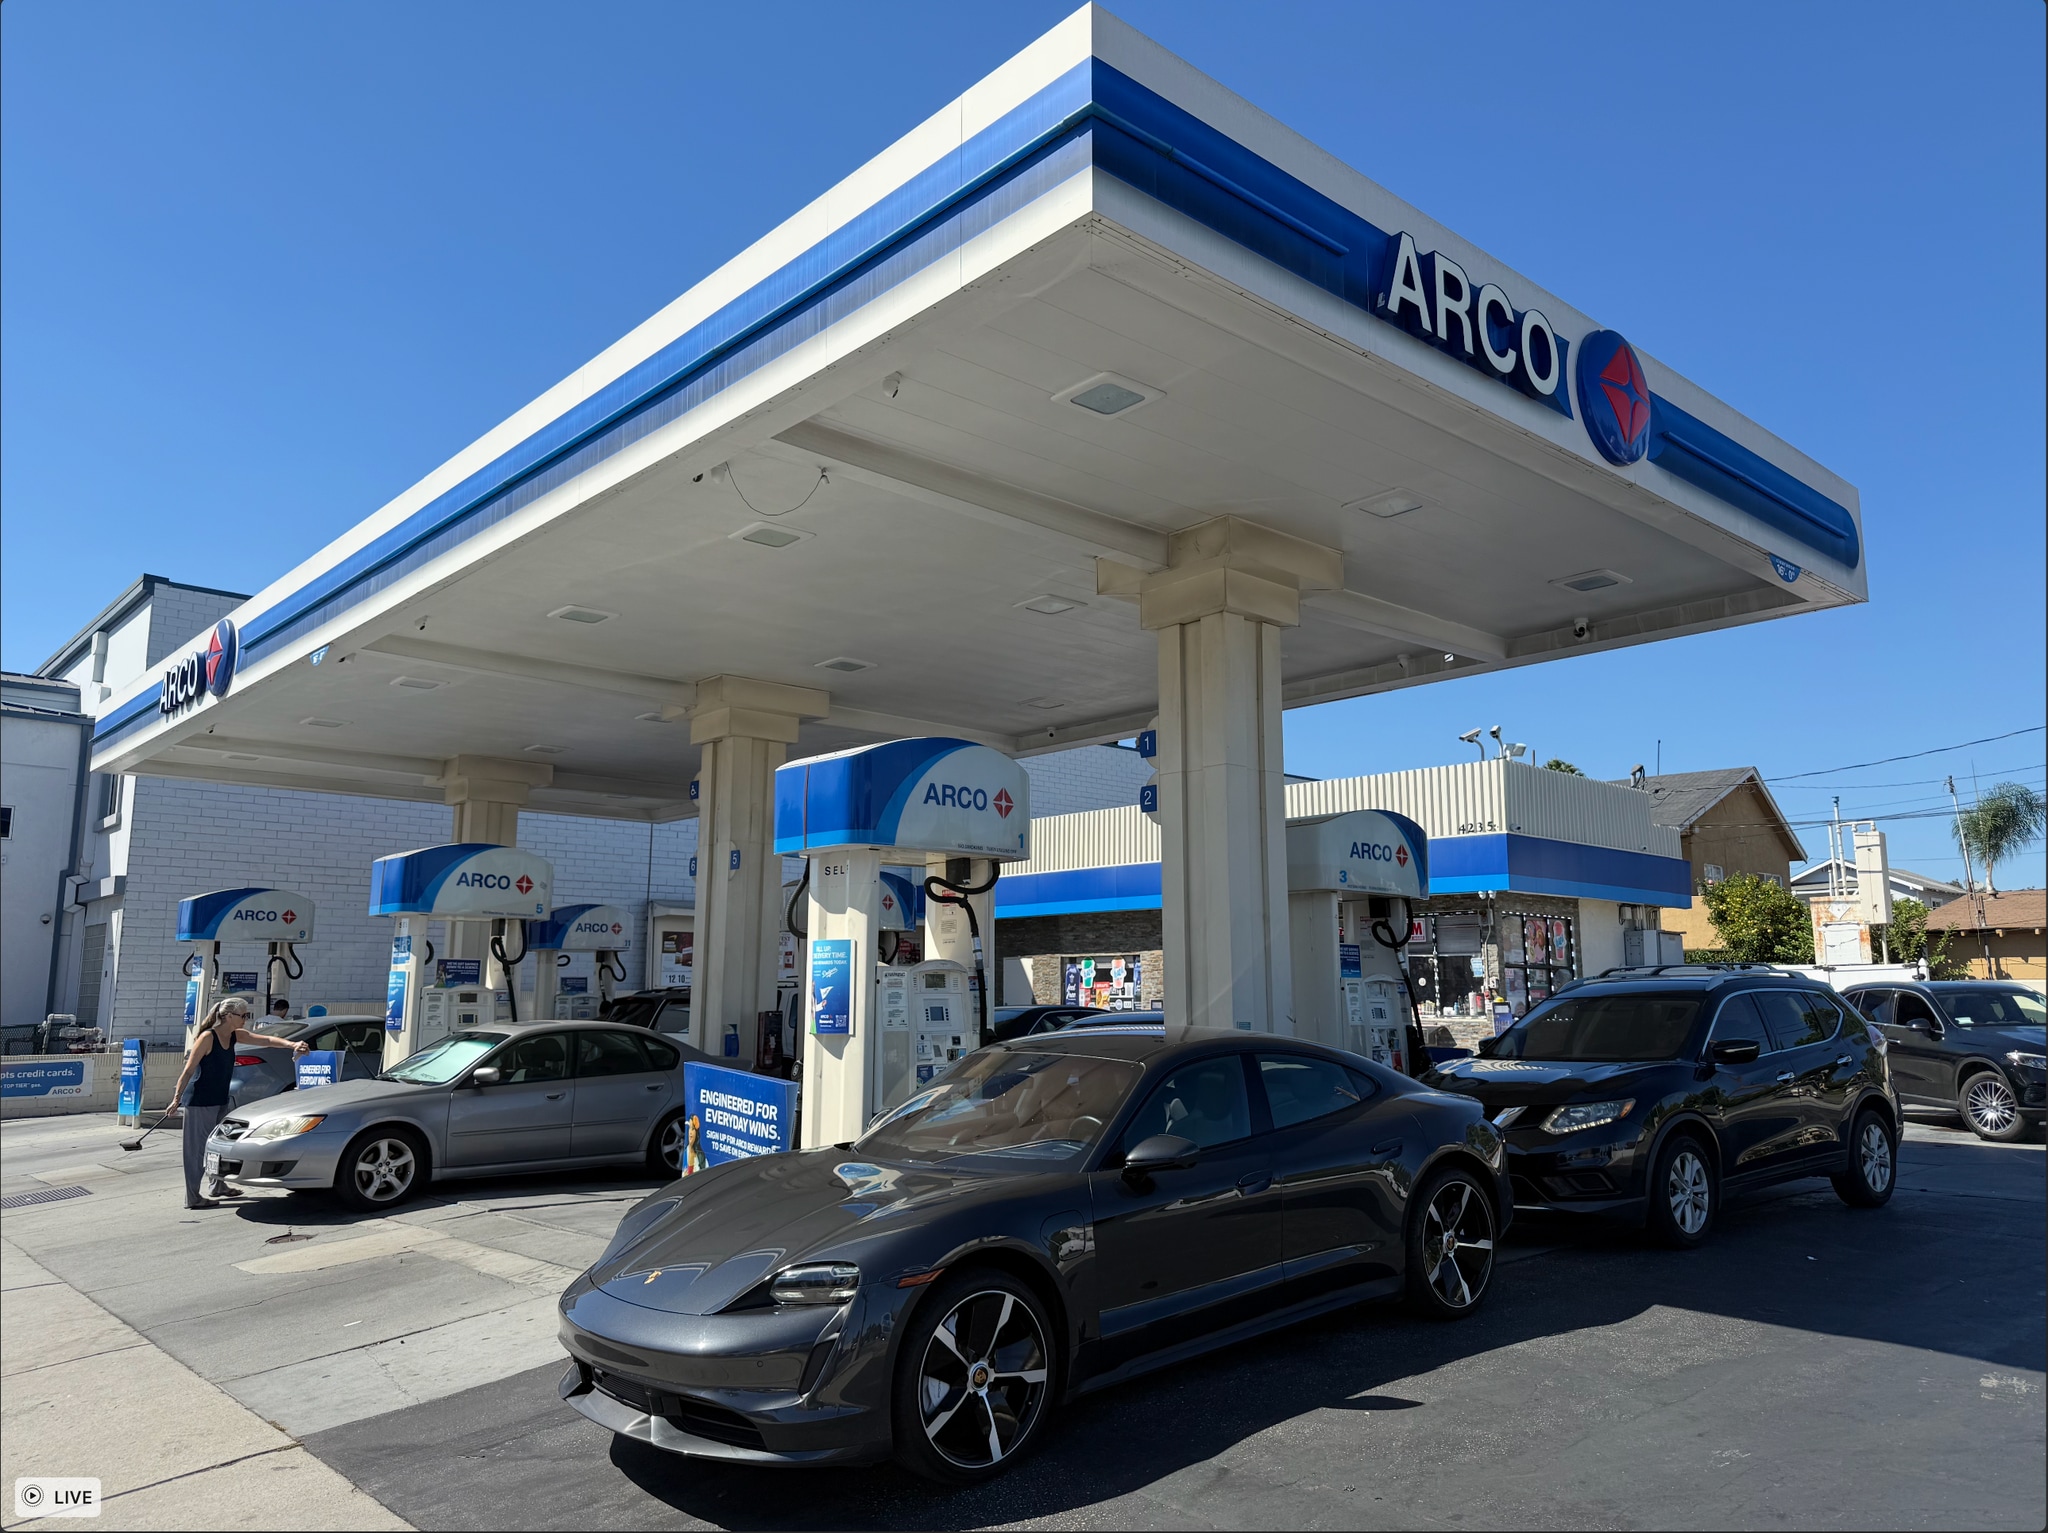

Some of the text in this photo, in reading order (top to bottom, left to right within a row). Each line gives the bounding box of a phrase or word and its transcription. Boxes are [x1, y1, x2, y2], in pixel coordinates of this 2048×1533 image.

[1387, 231, 1559, 396] ARCO
[159, 651, 198, 713] ARCO
[1144, 736, 1150, 751] 1
[923, 783, 988, 811] ARCO
[1144, 791, 1152, 805] 2
[1018, 833, 1024, 849] 1
[1350, 841, 1392, 862] ARCO
[691, 860, 696, 871] 6
[732, 853, 738, 865] 5
[456, 872, 511, 890] ARCO
[1339, 870, 1347, 883] 3
[233, 910, 277, 921] ARCO
[536, 904, 543, 914] 5
[299, 930, 306, 938] 9
[575, 923, 609, 933] ARCO
[17, 1070, 45, 1078] credit
[47, 1068, 76, 1077] cards.
[700, 1088, 778, 1121] ENGINEERED FOR
[705, 1108, 781, 1140] EVERYDAY WINS.
[706, 1129, 719, 1141] SIGN
[736, 1137, 747, 1149] ARCO
[711, 1141, 719, 1151] TO
[719, 1143, 731, 1154] SAVE
